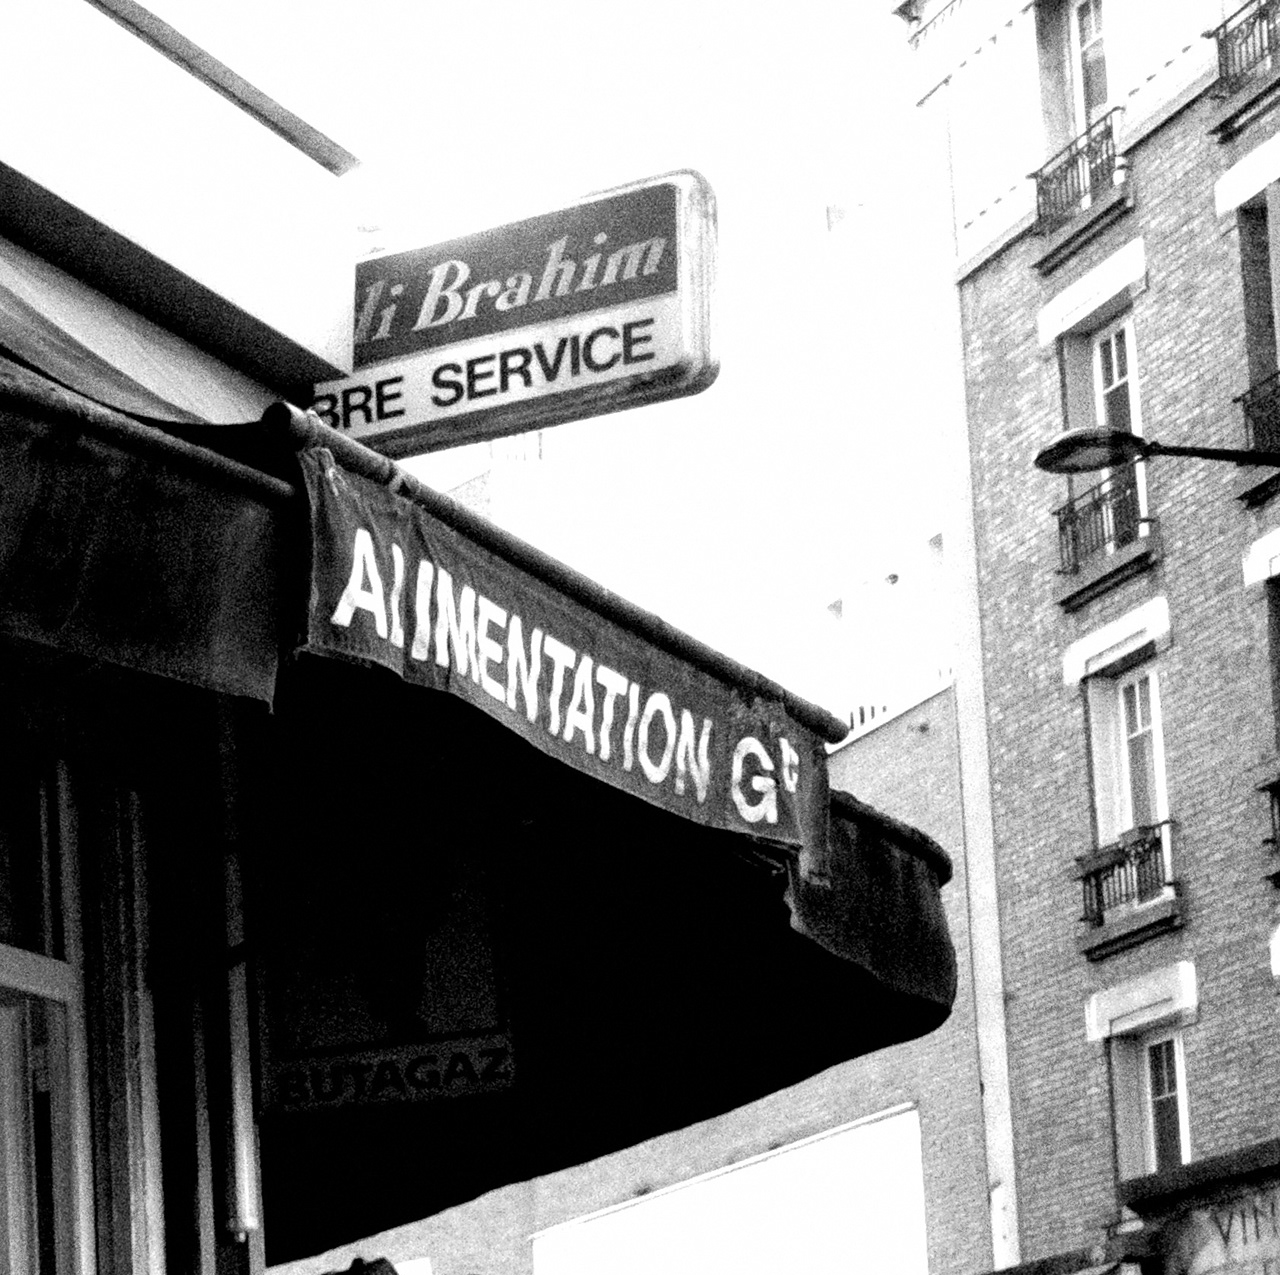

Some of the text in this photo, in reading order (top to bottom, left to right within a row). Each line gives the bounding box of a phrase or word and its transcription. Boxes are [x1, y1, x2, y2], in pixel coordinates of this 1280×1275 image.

[410, 233, 667, 332] Brahim
[431, 318, 655, 408] SERVICE
[277, 1048, 512, 1105] BUTAGAZ
